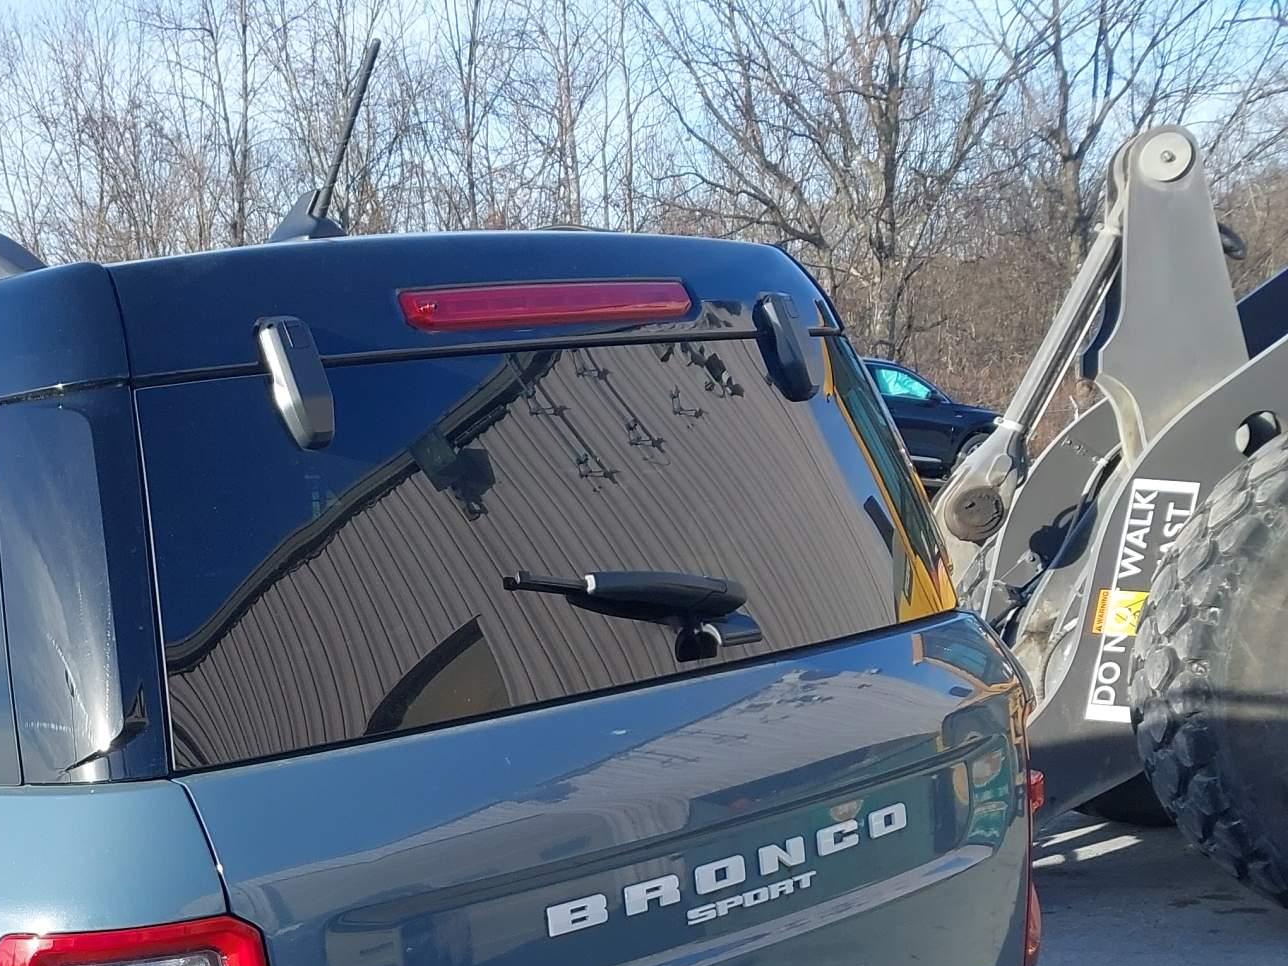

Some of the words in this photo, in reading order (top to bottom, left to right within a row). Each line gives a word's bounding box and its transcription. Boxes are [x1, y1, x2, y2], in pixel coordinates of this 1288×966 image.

[1091, 661, 1121, 706] DO
[1118, 489, 1158, 580] WALK
[1095, 590, 1110, 626] WARNING
[546, 802, 908, 938] BRONCO
[686, 870, 817, 926] SPORT
